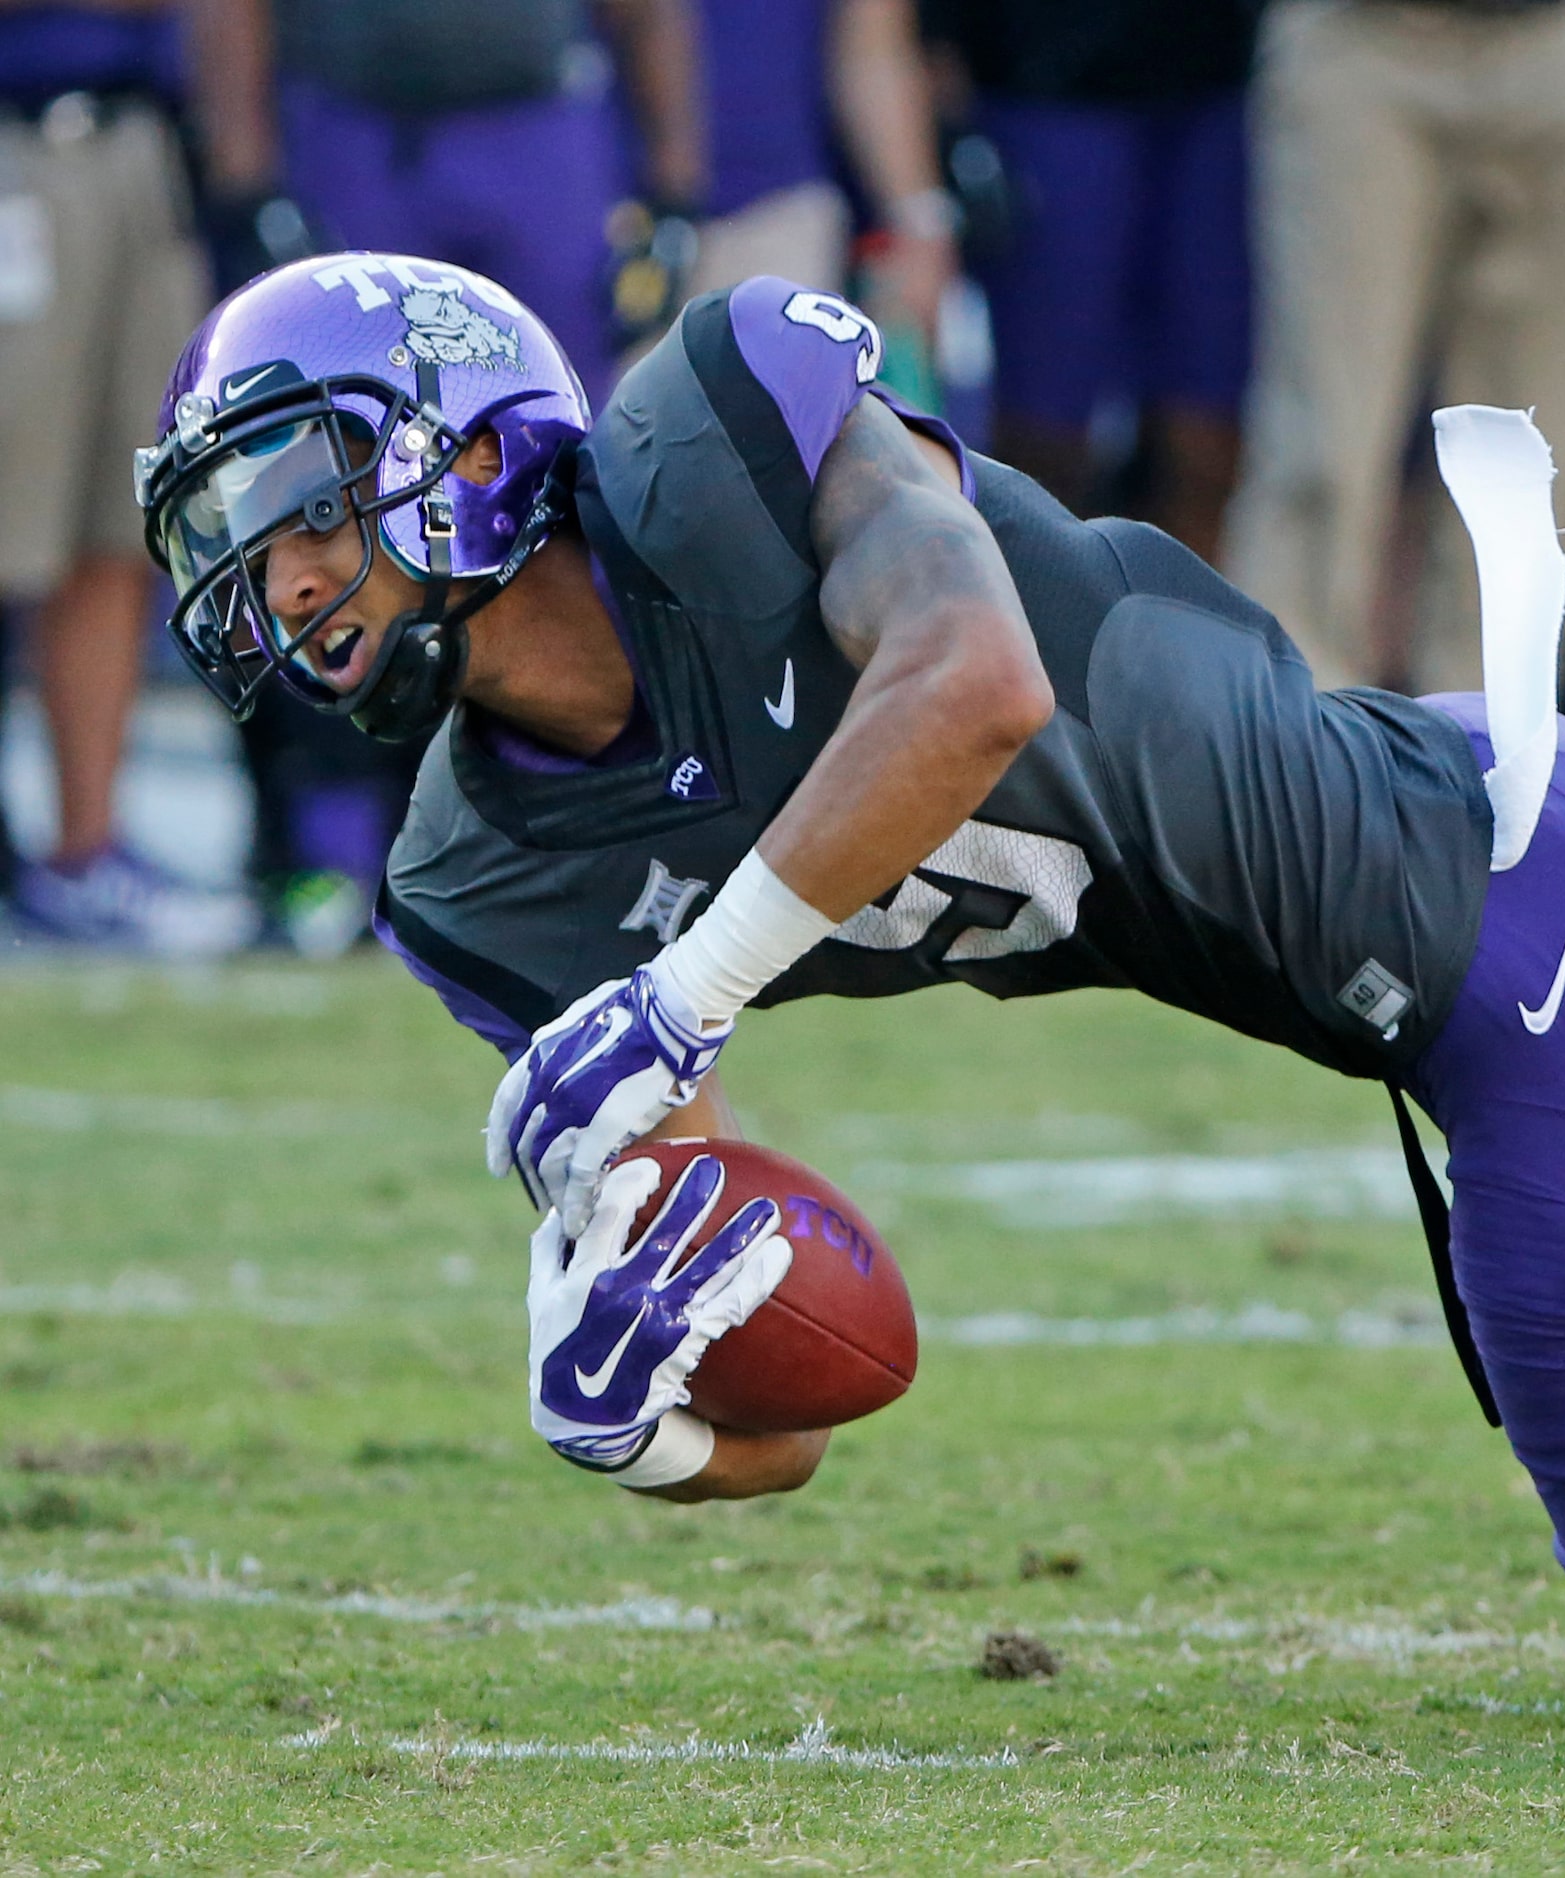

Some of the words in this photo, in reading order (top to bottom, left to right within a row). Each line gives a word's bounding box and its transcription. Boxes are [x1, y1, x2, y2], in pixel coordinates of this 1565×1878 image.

[311, 253, 524, 318] TCU
[782, 292, 881, 386] 9
[670, 755, 703, 796] TCU
[1352, 982, 1376, 1006] 40
[785, 1194, 873, 1278] TCU
